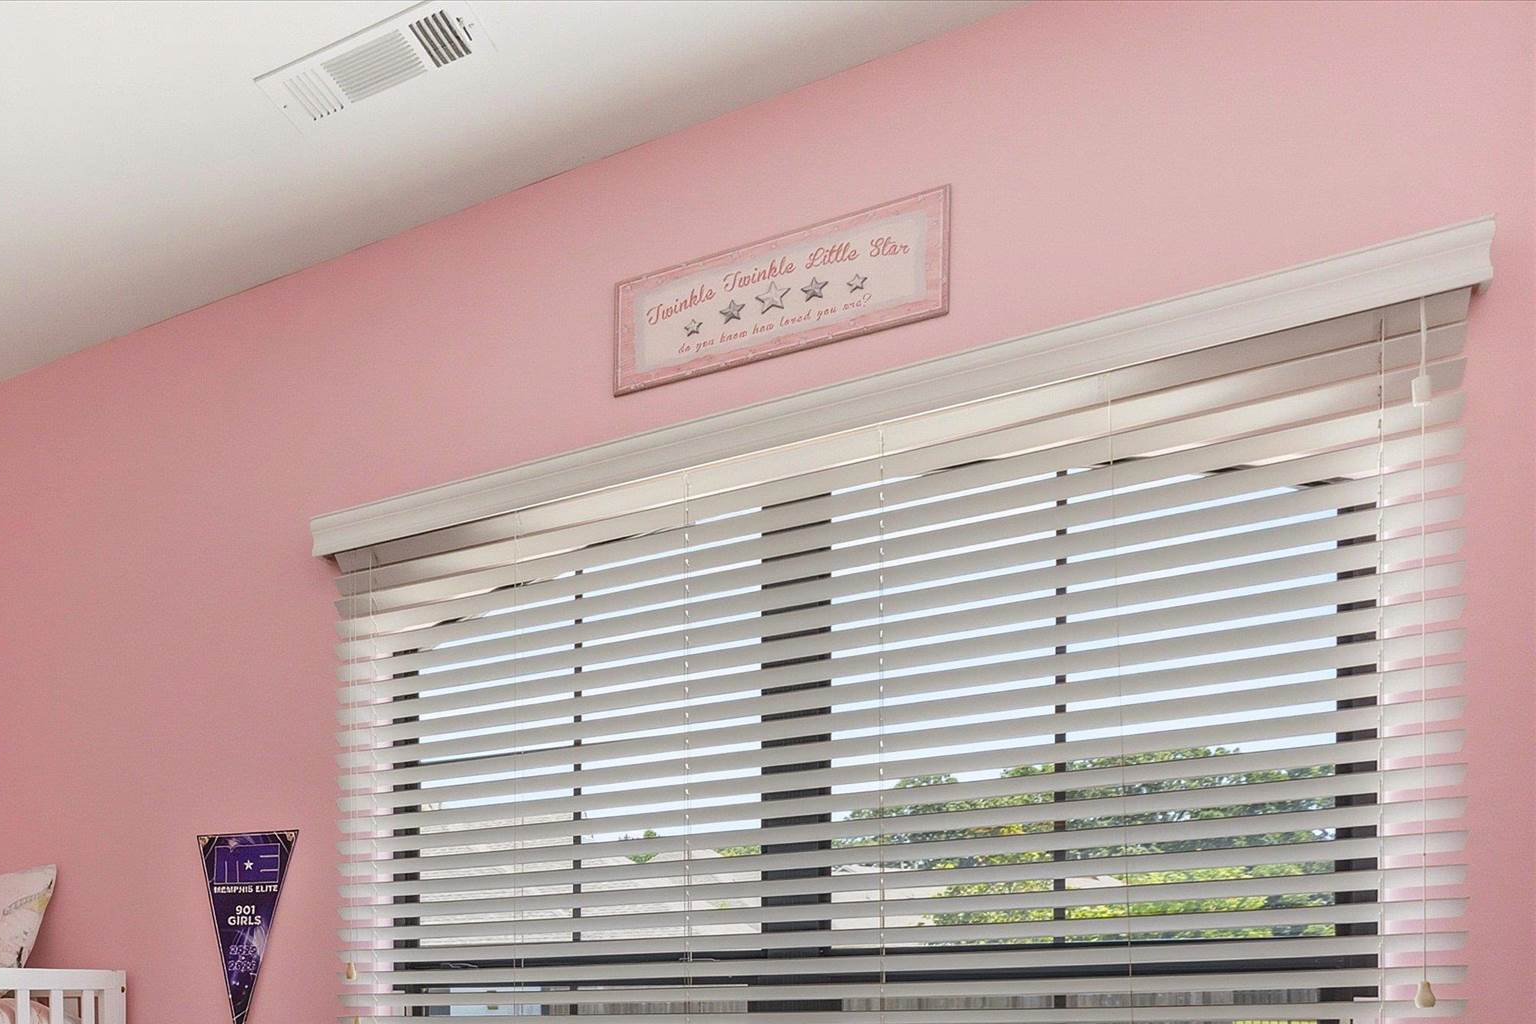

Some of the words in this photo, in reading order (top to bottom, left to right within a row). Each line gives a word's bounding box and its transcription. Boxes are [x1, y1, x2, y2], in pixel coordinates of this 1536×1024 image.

[646, 284, 716, 326] Twinkle
[723, 256, 796, 292] Twinkle
[805, 242, 860, 269] Little
[869, 236, 911, 257] Star
[678, 343, 691, 354] do
[695, 338, 714, 352] you
[720, 331, 747, 344] know
[752, 322, 774, 335] how
[780, 309, 812, 327] loved
[816, 306, 838, 321] you
[213, 885, 254, 894] MEMPHIS
[255, 884, 278, 893] ELITE
[235, 904, 256, 915] 901
[227, 915, 262, 926] GIRLS
